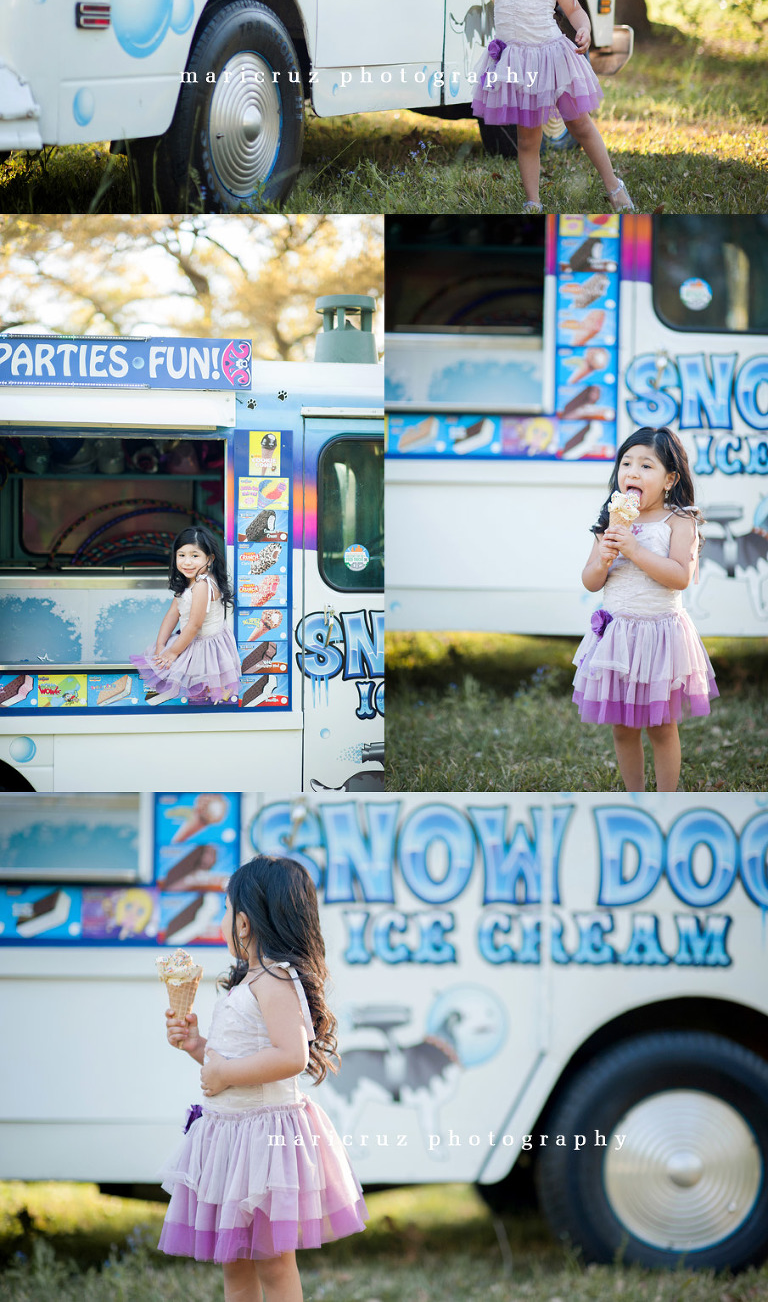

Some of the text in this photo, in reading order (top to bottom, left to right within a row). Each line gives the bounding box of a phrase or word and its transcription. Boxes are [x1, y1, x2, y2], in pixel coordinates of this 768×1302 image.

[150, 346, 220, 381] FUN!
[250, 802, 576, 905] SNOW
[343, 911, 733, 968] ICE CREAM
